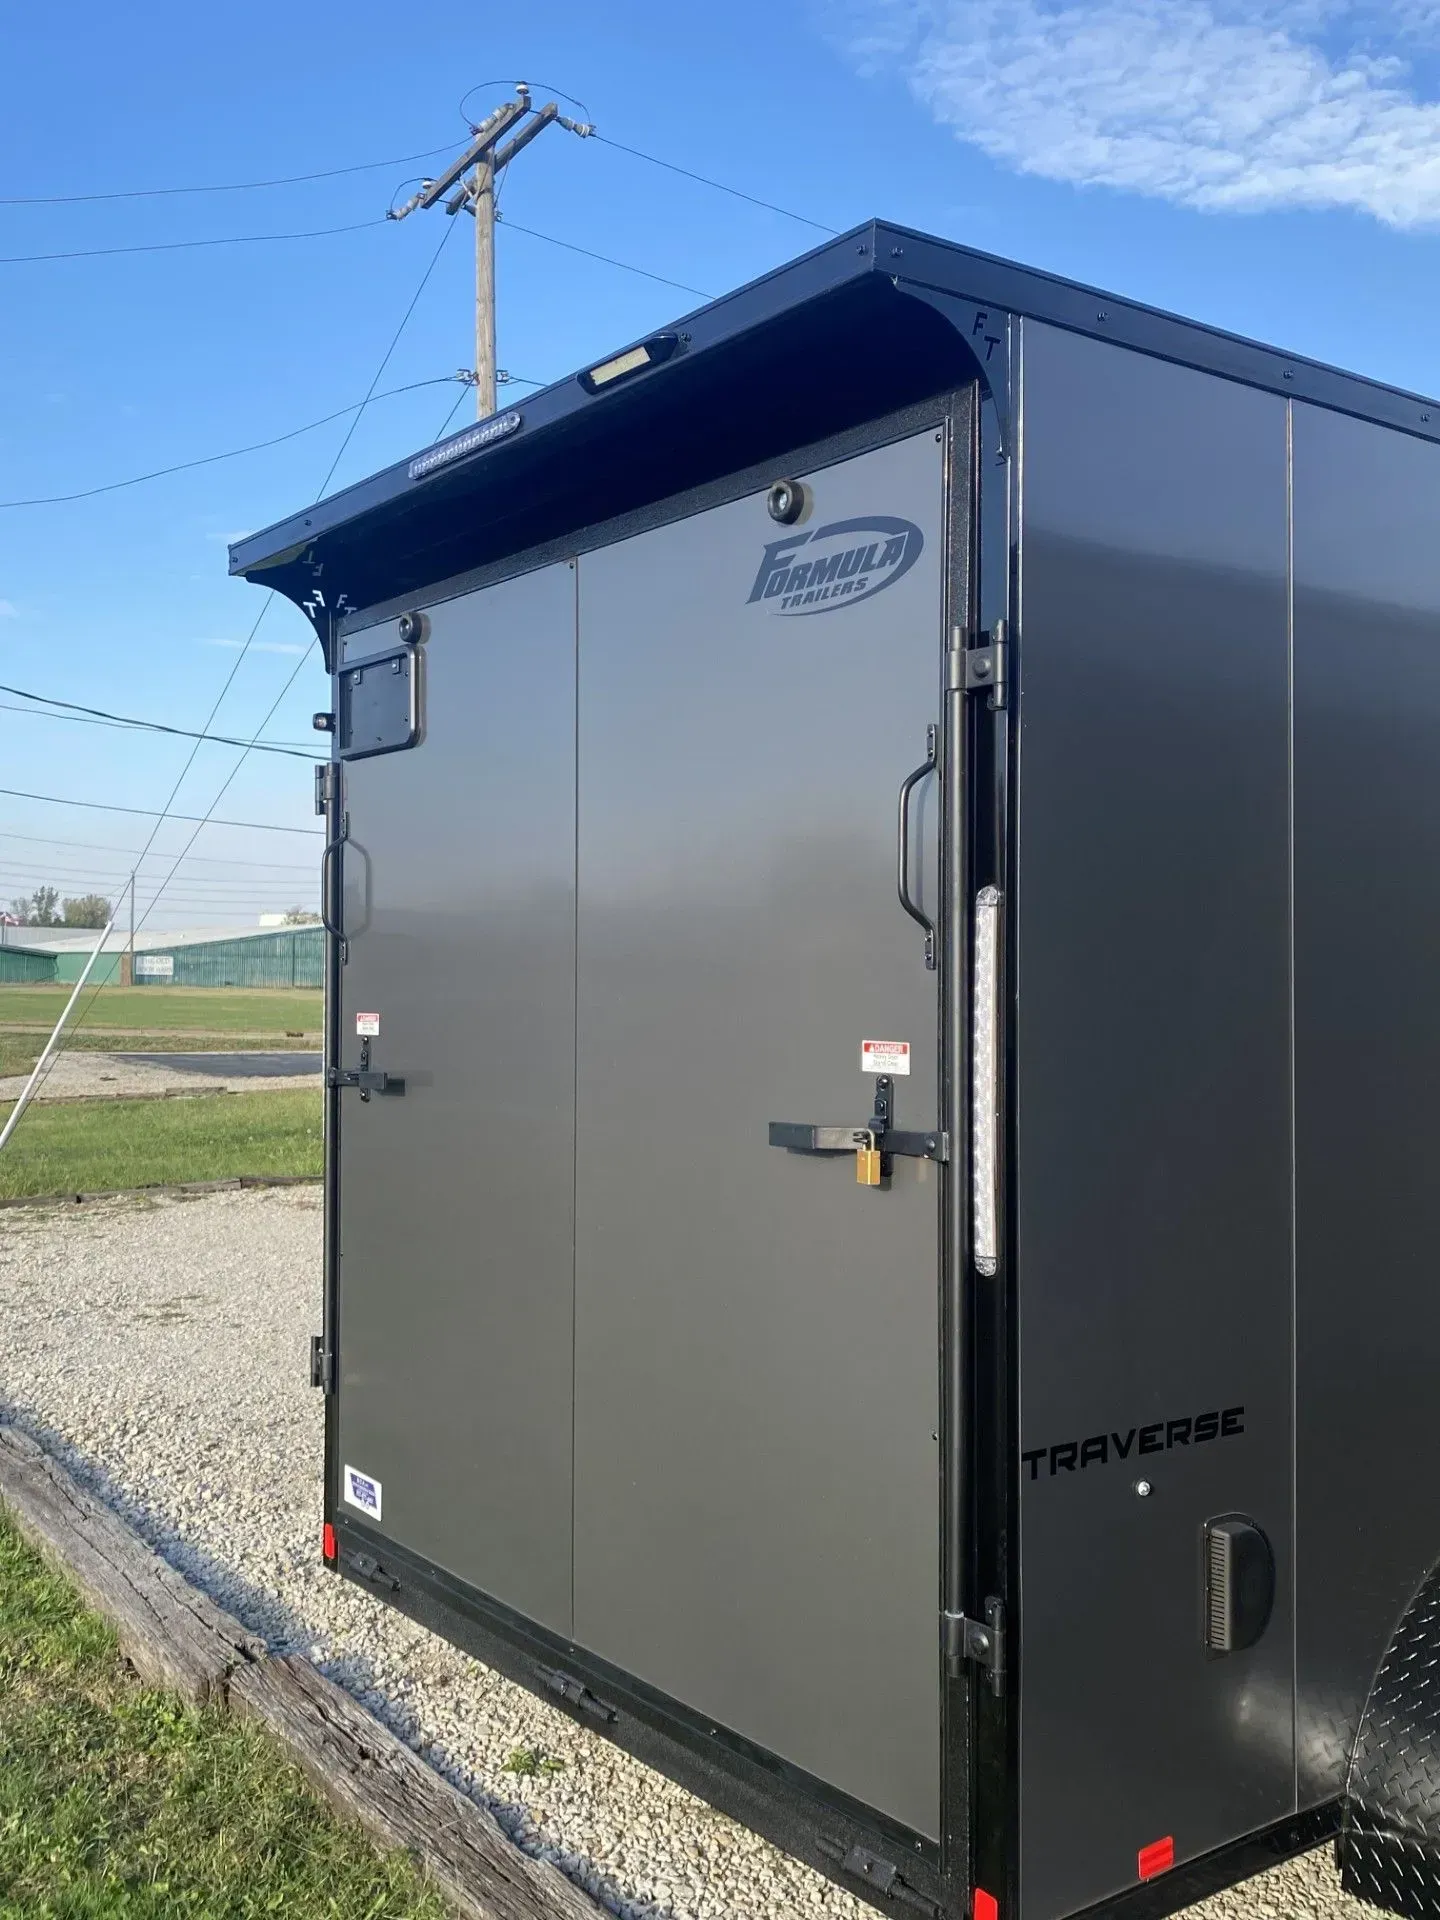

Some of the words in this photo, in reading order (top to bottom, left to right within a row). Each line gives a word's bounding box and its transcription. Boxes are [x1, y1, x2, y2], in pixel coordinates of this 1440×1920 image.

[745, 530, 909, 605] FORMULA
[780, 577, 869, 610] TRAILERS
[1021, 1406, 1245, 1481] TRAVERSE
